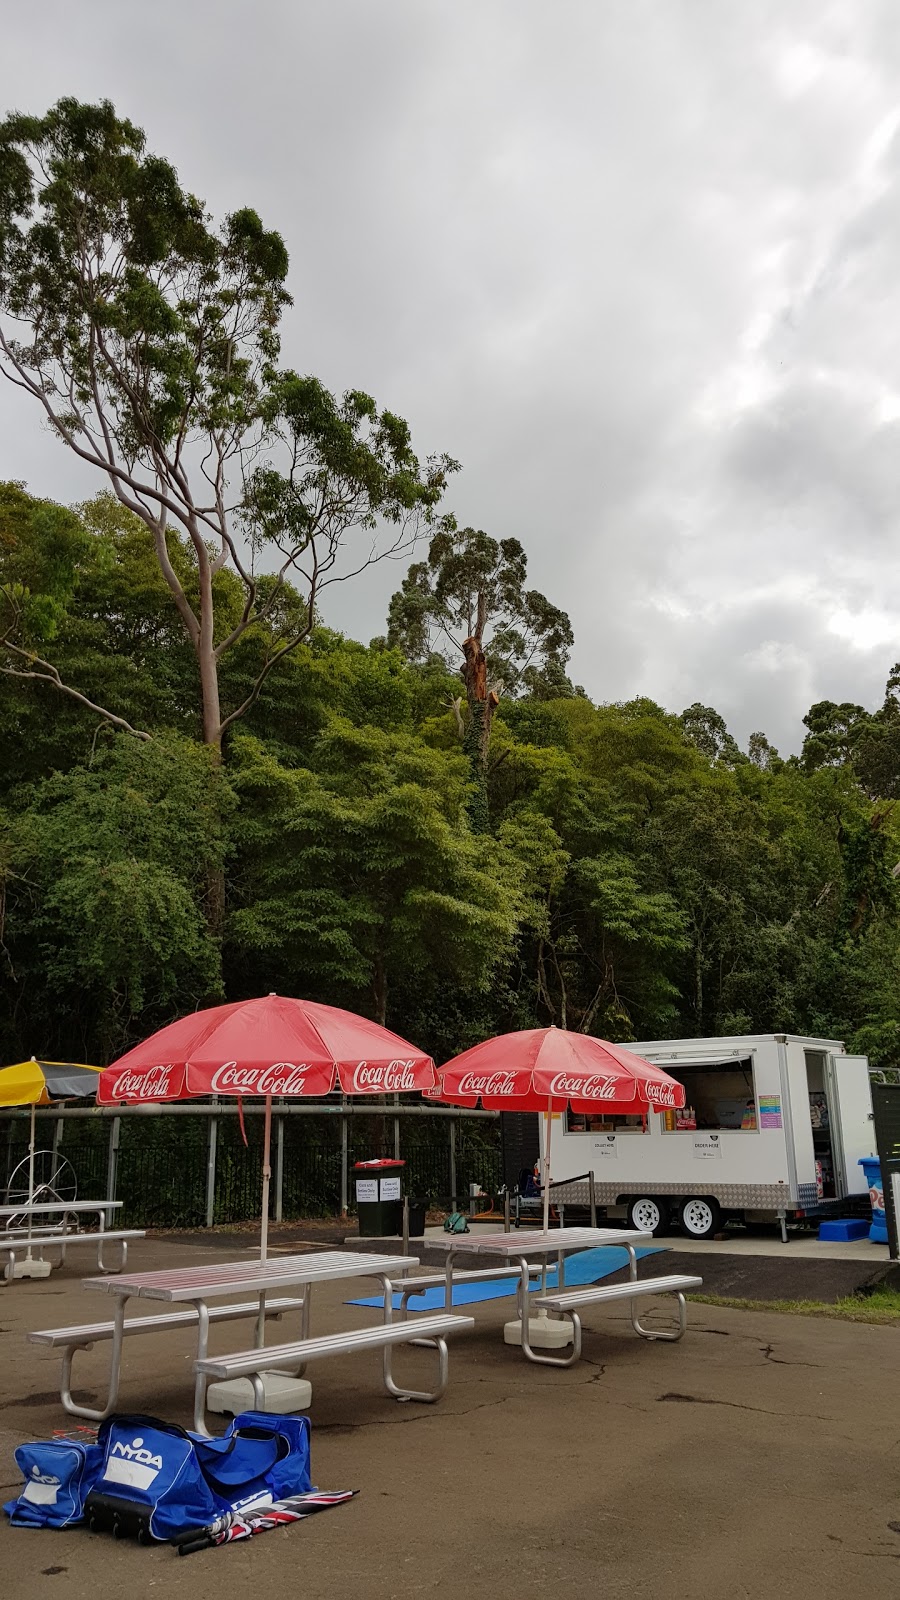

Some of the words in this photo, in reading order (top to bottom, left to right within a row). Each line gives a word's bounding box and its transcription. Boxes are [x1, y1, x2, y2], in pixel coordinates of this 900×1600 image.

[112, 1064, 175, 1098] Coca-Cola
[211, 1061, 313, 1094] Coca-Cola
[353, 1060, 416, 1092] Coca-Cola
[458, 1071, 519, 1095] Coca-Cola
[550, 1072, 620, 1099] Coca-Cola
[644, 1079, 676, 1106] Coca-Cola
[111, 1441, 163, 1470] NYDA
